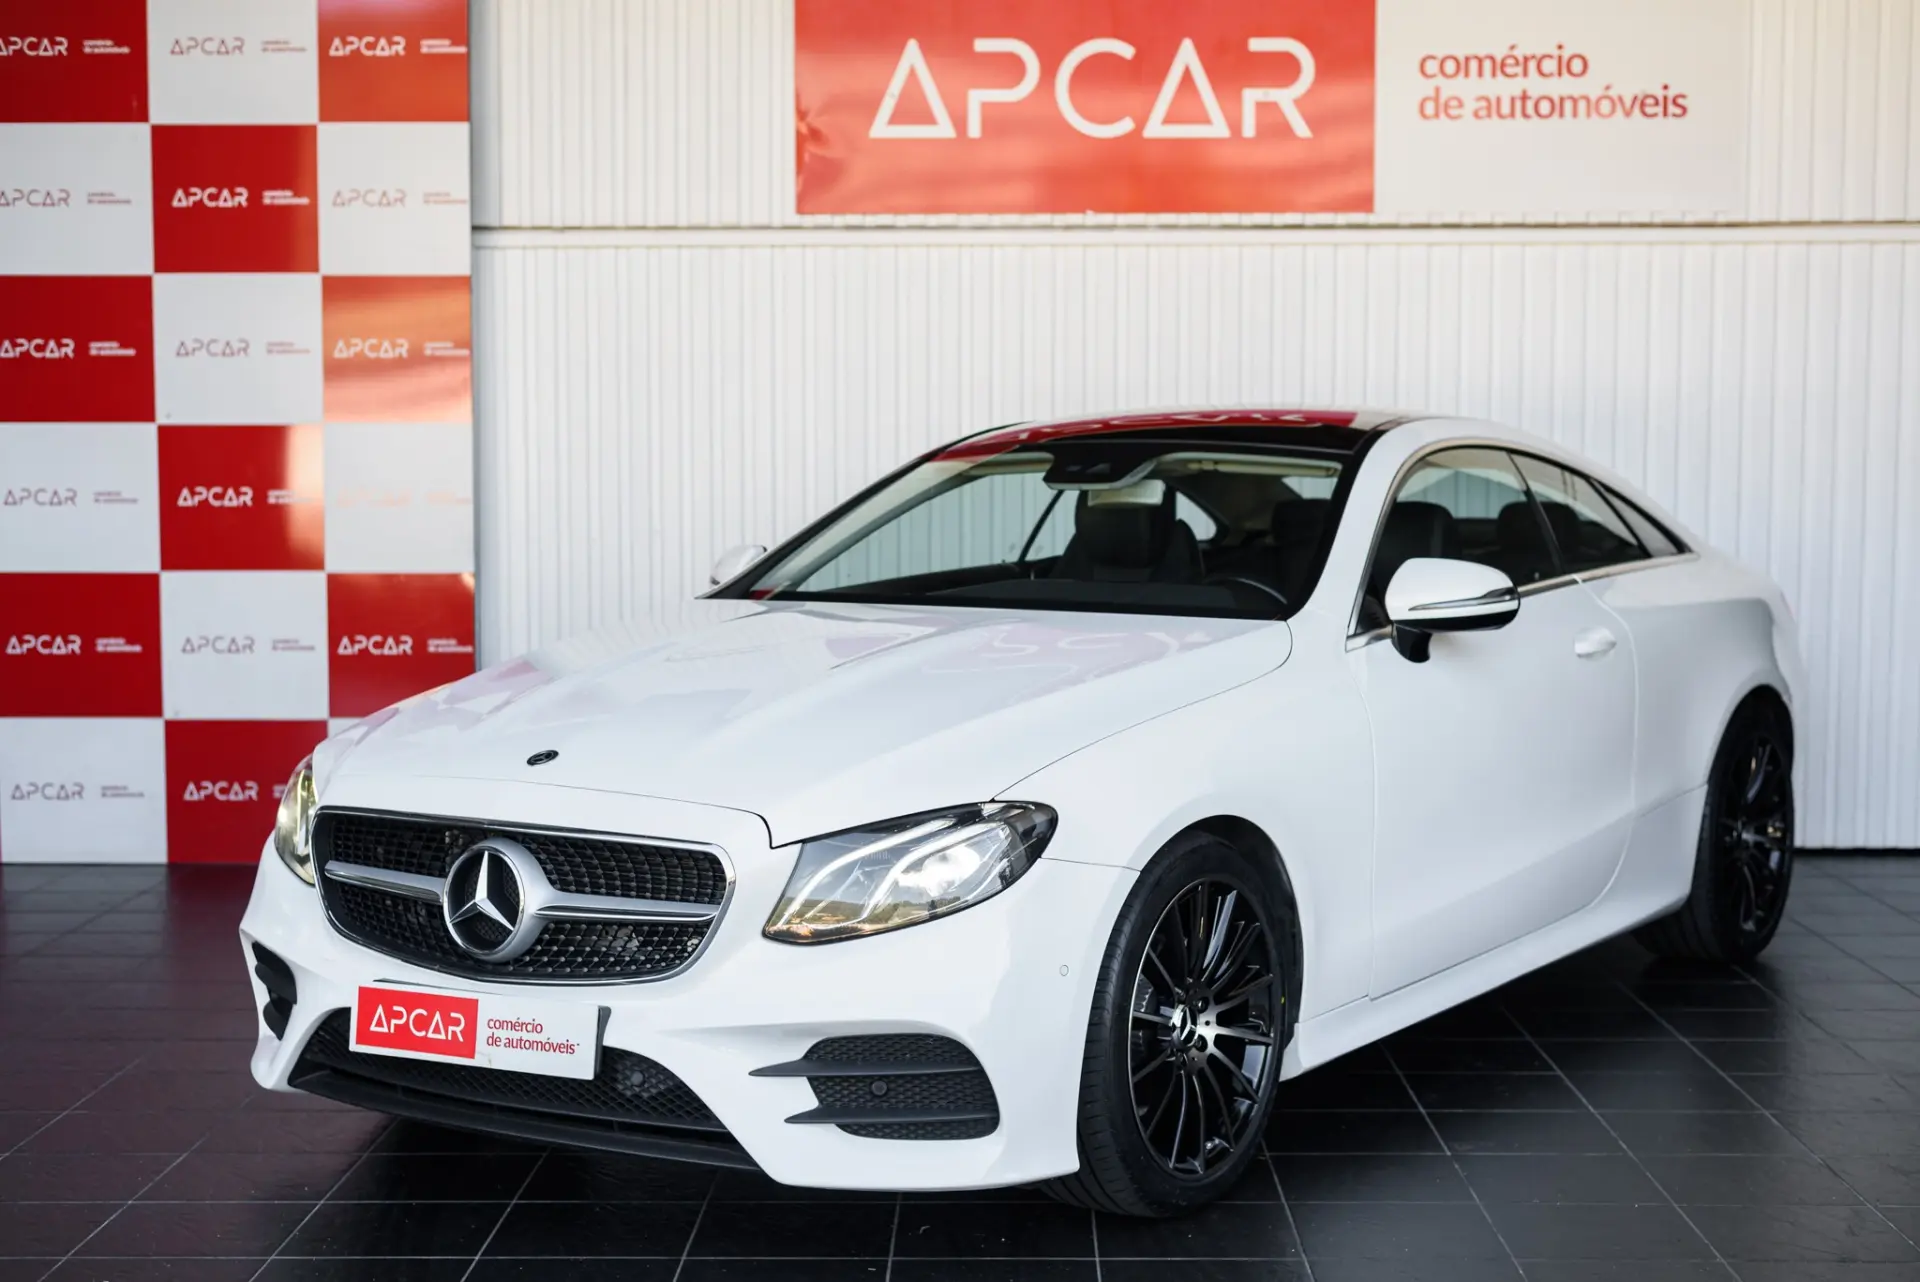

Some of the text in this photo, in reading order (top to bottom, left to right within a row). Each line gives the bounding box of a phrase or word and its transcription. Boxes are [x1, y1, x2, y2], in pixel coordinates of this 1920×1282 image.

[170, 36, 245, 56] APCAR
[329, 36, 405, 56] APCAR
[1419, 43, 1588, 80] comércio
[868, 37, 1317, 140] APCAR
[1419, 82, 1688, 121] de automóveis
[171, 187, 248, 208] APCAR
[0, 338, 75, 359] APCAR
[175, 338, 250, 359] APCAR
[333, 338, 409, 359] APCAR
[3, 487, 77, 507] APCAR
[177, 486, 253, 507] APCAR
[5, 635, 81, 655] APCAR
[181, 635, 255, 655] APCAR
[337, 635, 412, 655] APCAR
[11, 782, 83, 801] APCAR
[183, 781, 259, 801] APCAR
[369, 1003, 465, 1042] APCAR
[487, 1017, 543, 1034] comércio
[486, 1032, 576, 1055] de automóveis
